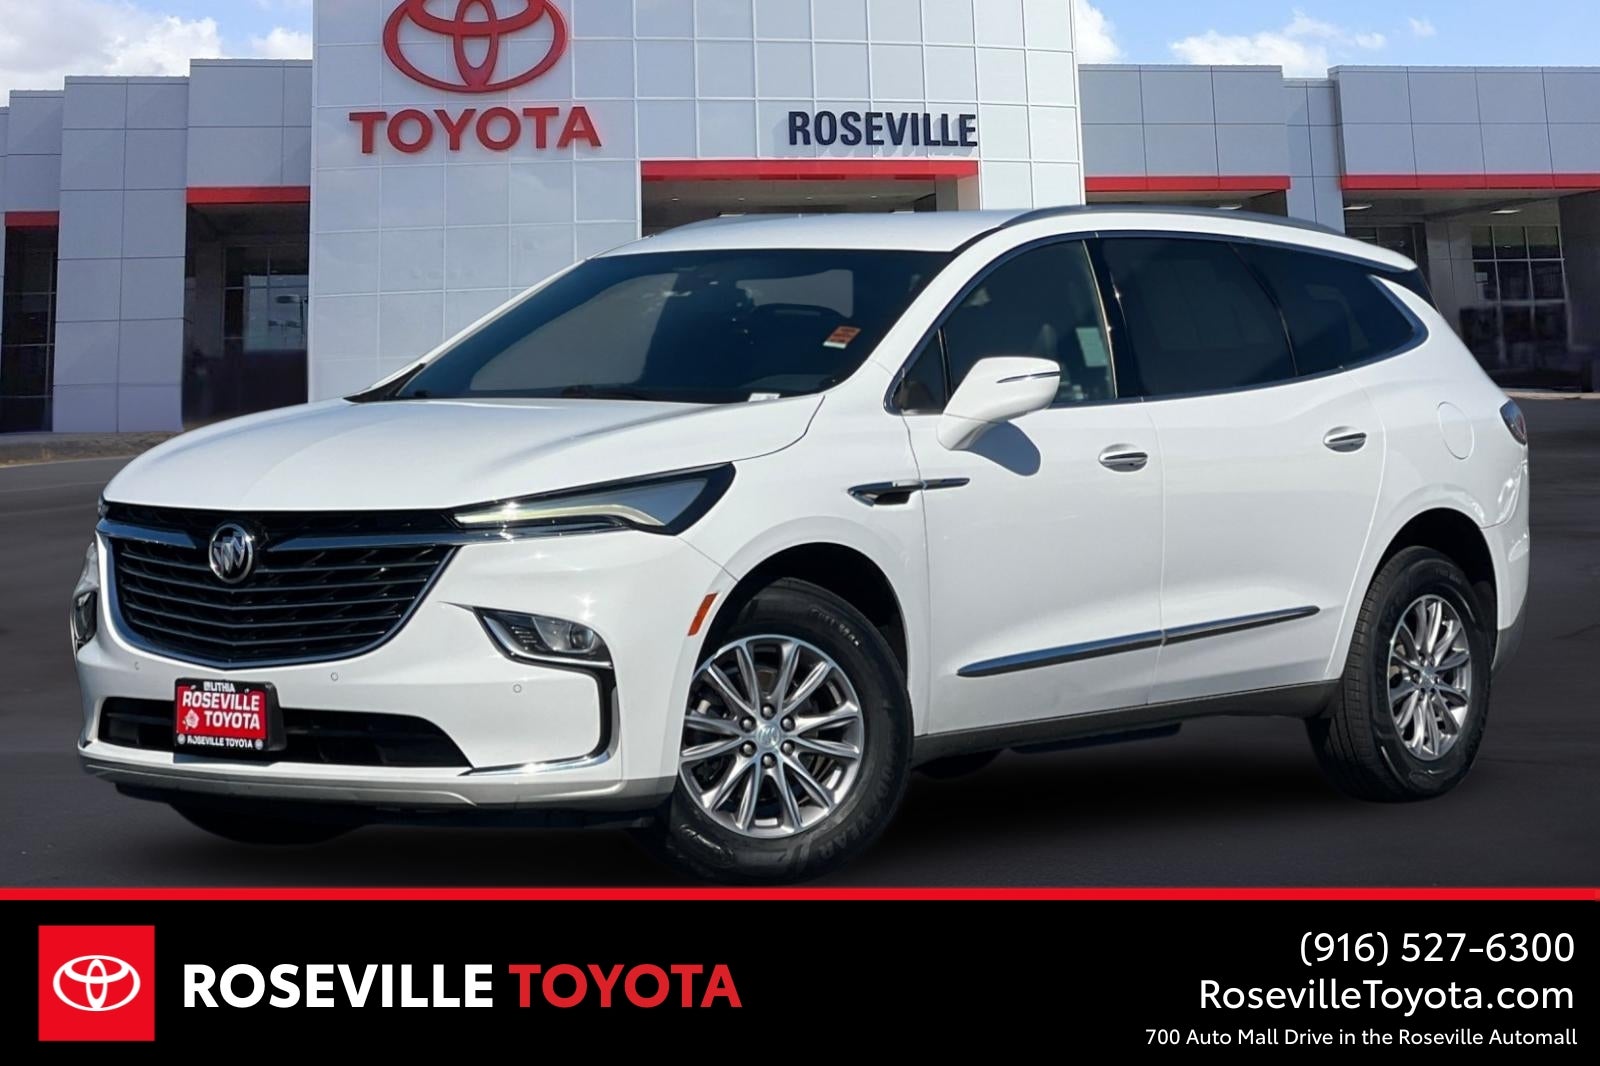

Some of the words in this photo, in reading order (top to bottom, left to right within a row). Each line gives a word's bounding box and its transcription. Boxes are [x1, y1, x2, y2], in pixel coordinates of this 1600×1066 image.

[349, 107, 602, 153] TOYOTA
[788, 111, 978, 147] ROSEVILLE
[210, 682, 235, 692] LITHIA
[182, 691, 260, 711] ROSEVILLE
[204, 710, 260, 730] TOYOTA
[187, 735, 224, 746] ROSEVILLE
[225, 738, 253, 748] TOYOTA
